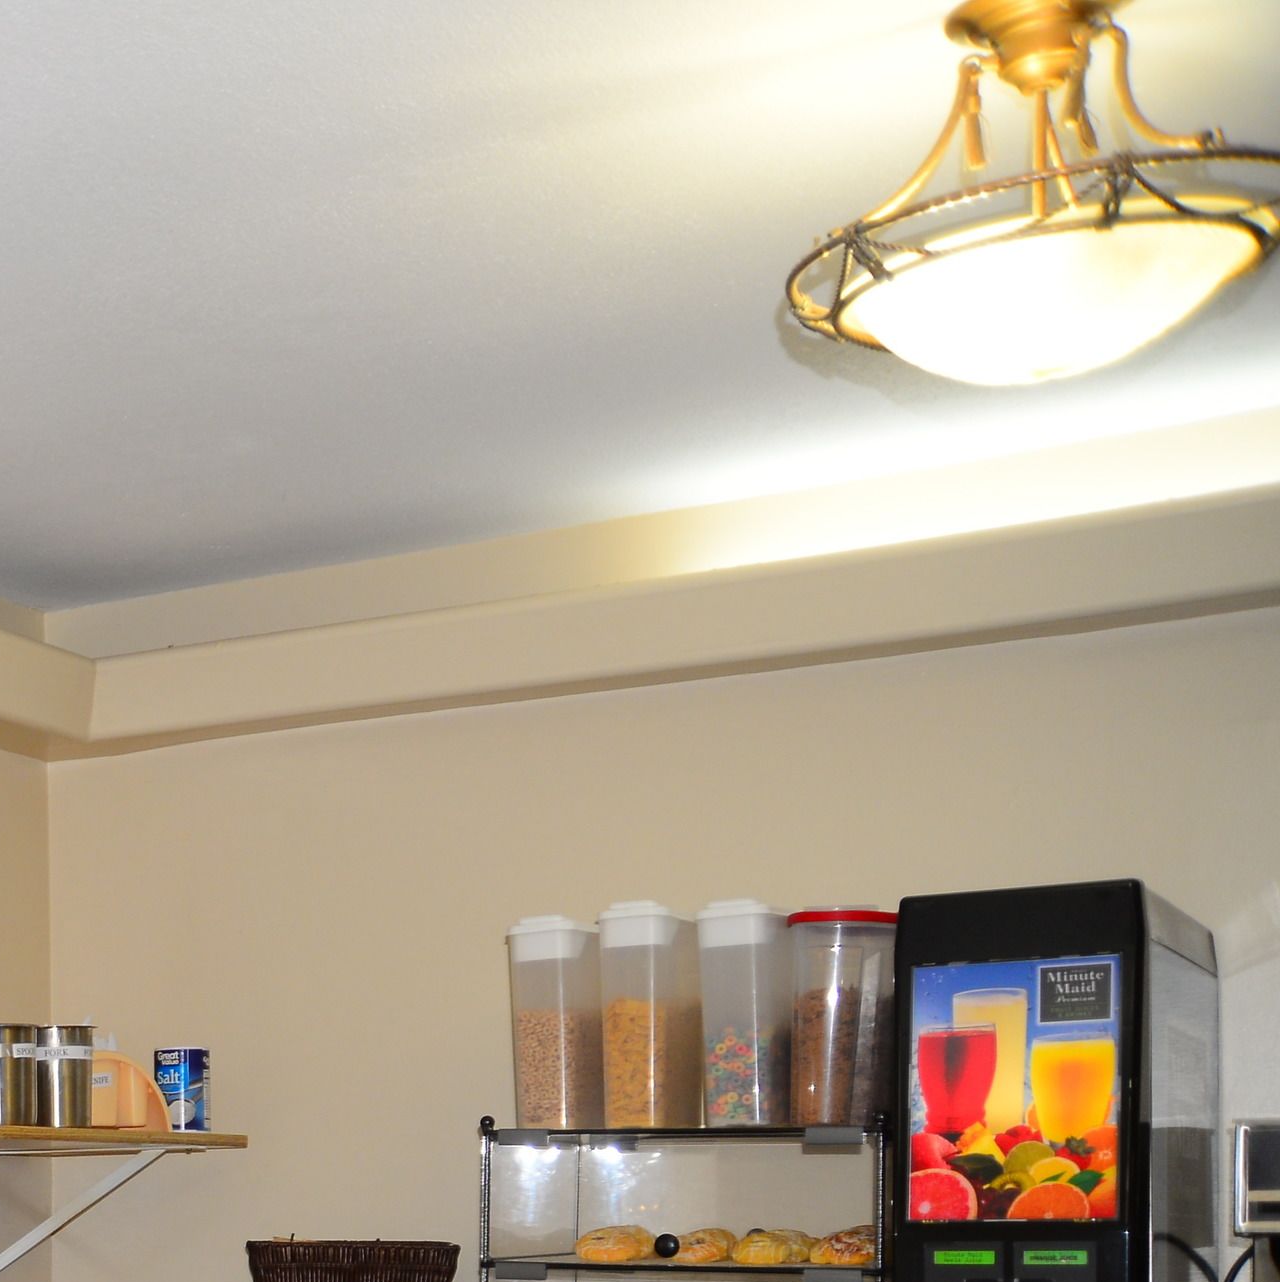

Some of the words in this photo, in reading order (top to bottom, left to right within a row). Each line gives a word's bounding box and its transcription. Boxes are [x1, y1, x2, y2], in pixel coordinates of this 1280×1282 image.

[1047, 971, 1105, 983] Minute
[1056, 981, 1096, 994] Maid
[44, 1048, 69, 1058] FORK
[157, 1050, 180, 1061] Great
[161, 1058, 180, 1066] Value
[157, 1068, 181, 1085] Salt
